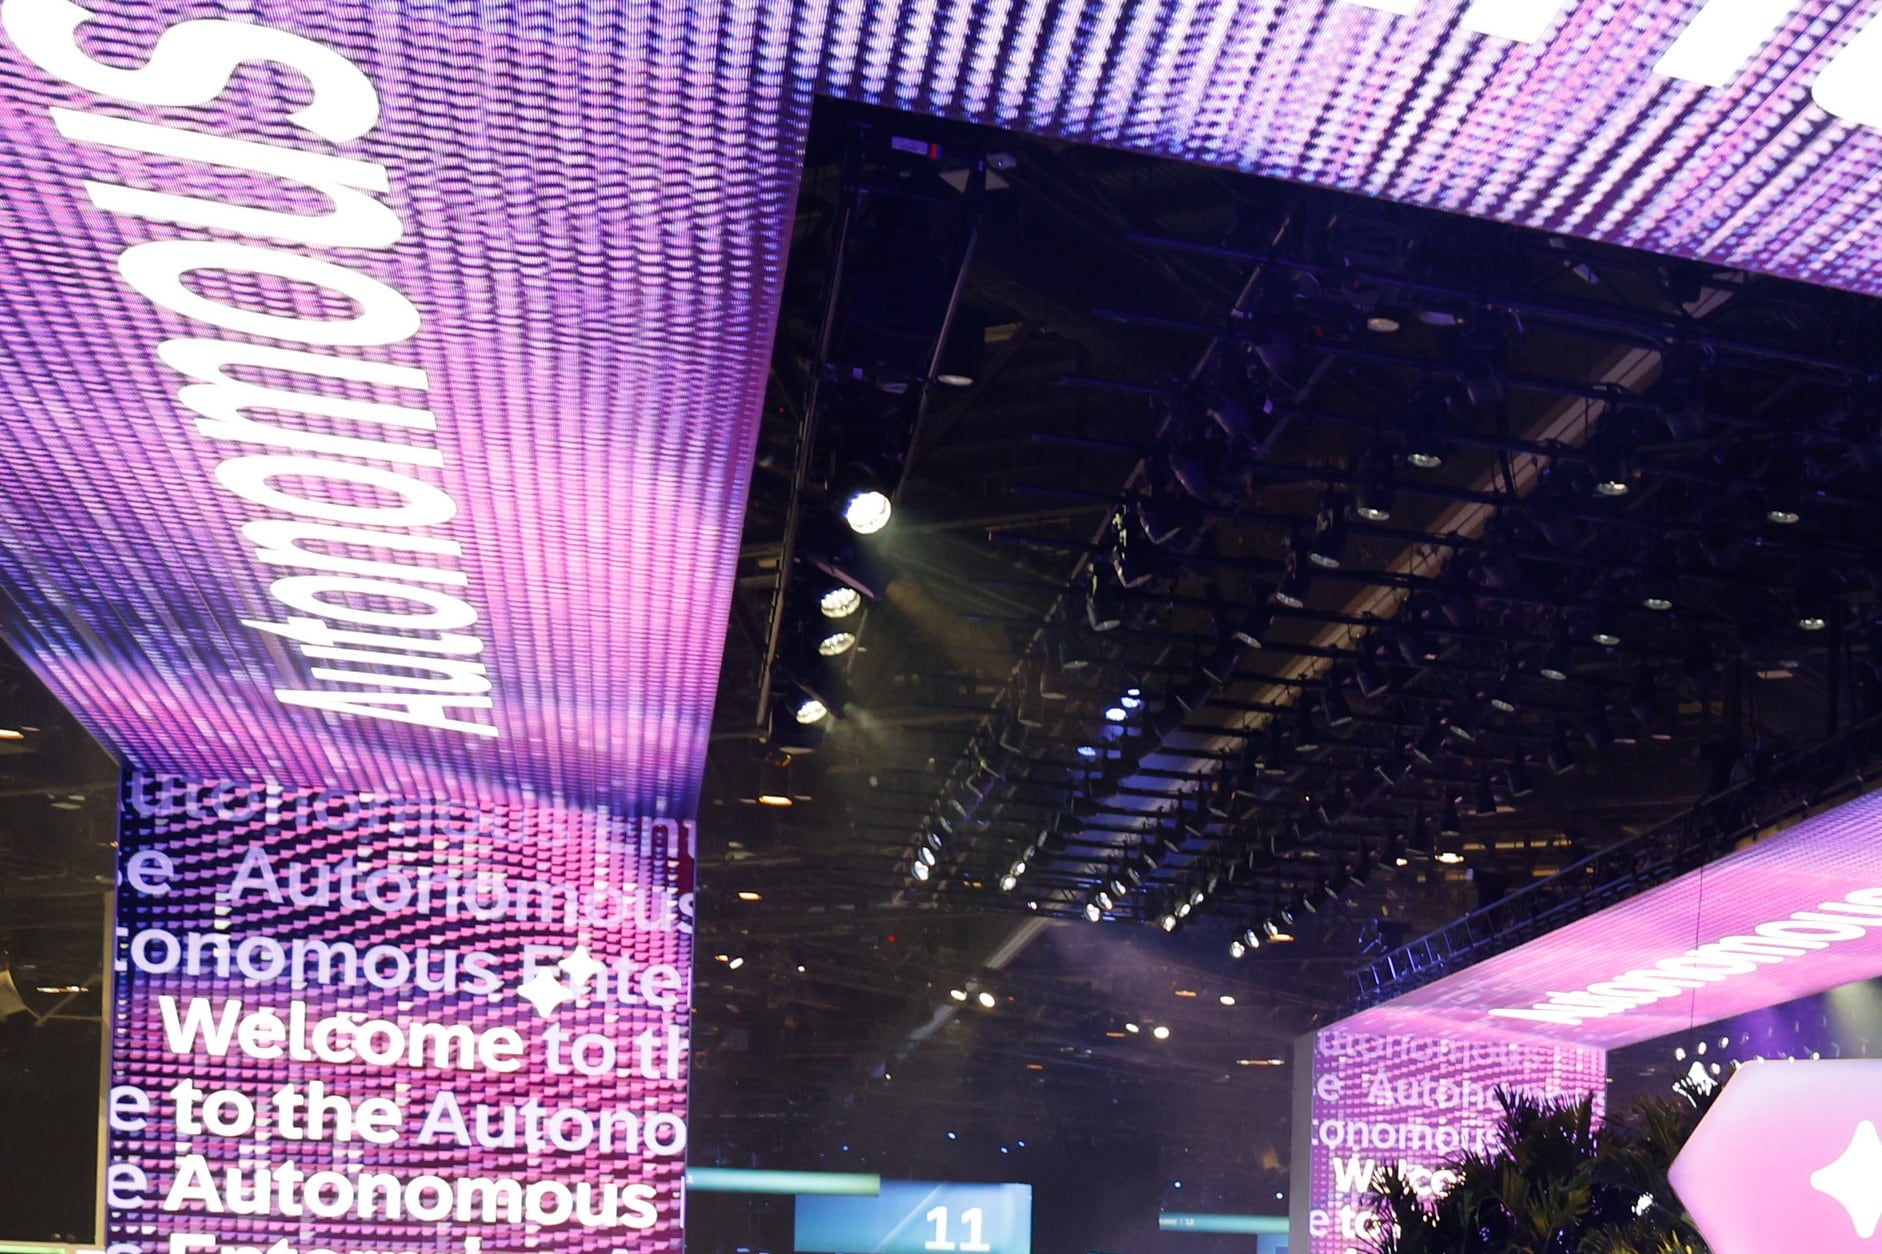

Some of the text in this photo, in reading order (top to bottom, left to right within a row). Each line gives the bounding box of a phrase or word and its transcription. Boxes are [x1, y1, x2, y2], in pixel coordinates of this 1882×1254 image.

[0, 0, 499, 738] Autonomous
[159, 996, 524, 1073] Welcome
[546, 1026, 616, 1076] to
[170, 1078, 254, 1136] to
[275, 1081, 400, 1143] the
[163, 1154, 658, 1229] Autonomous
[925, 1206, 991, 1252] 11
